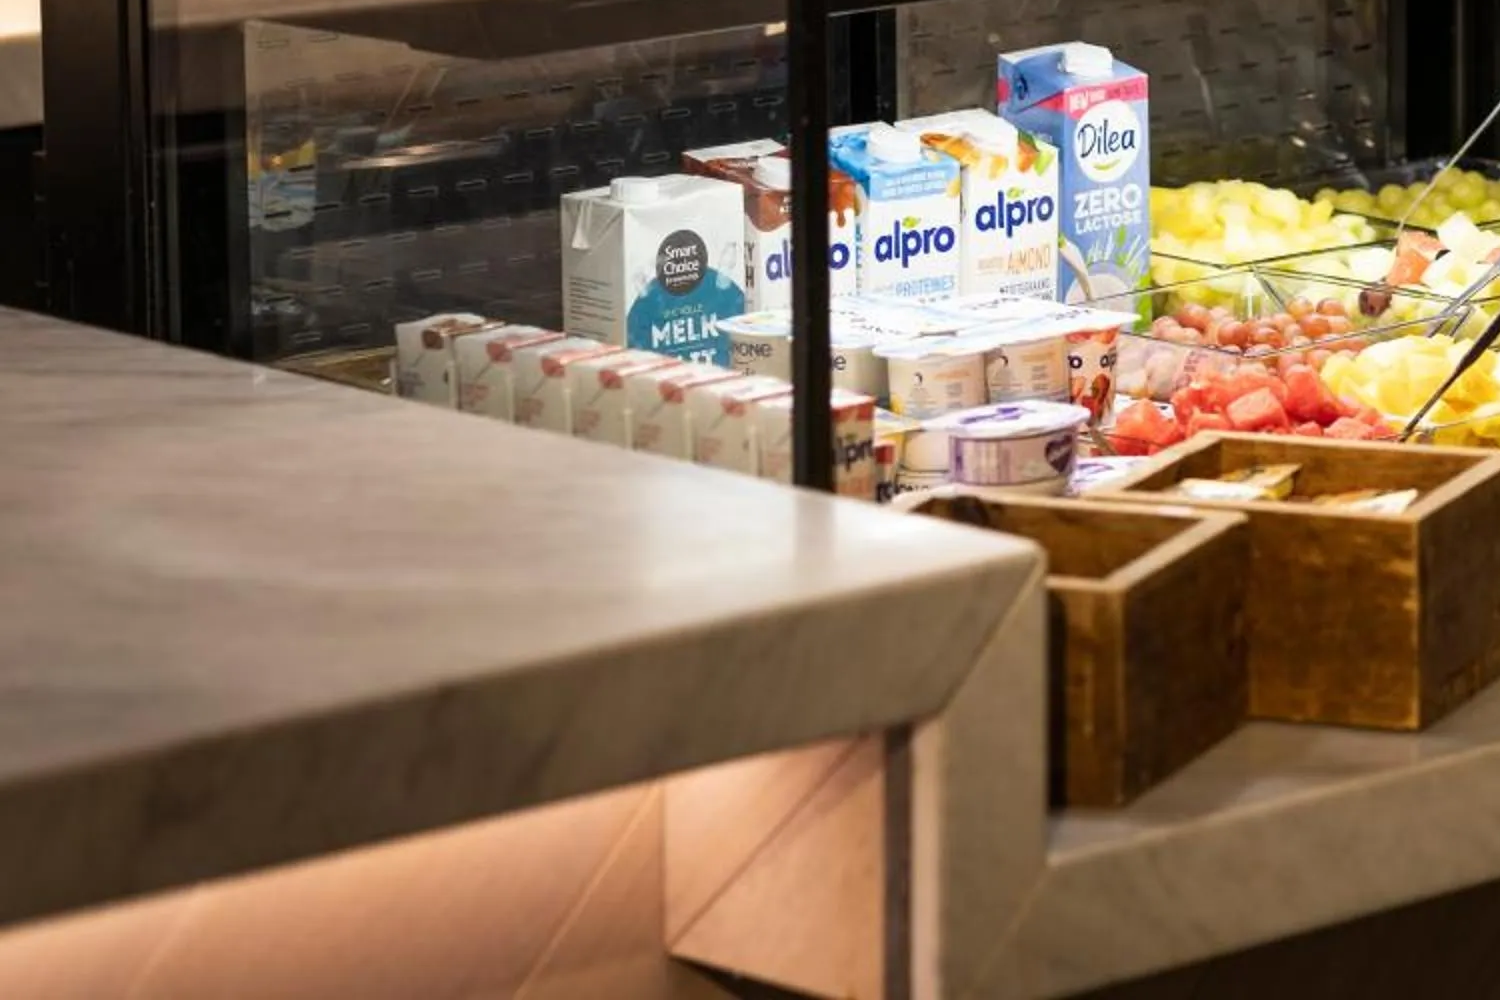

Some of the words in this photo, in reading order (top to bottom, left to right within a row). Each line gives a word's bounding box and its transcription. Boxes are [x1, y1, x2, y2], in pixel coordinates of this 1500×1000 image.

[1077, 119, 1136, 158] Dilea
[975, 190, 1054, 238] alpro
[1073, 183, 1142, 219] ZERO
[1075, 209, 1142, 235] LACTOSE
[664, 244, 698, 260] Smart
[874, 219, 955, 268] alpro
[663, 260, 699, 276] Choice
[651, 312, 719, 349] MELK
